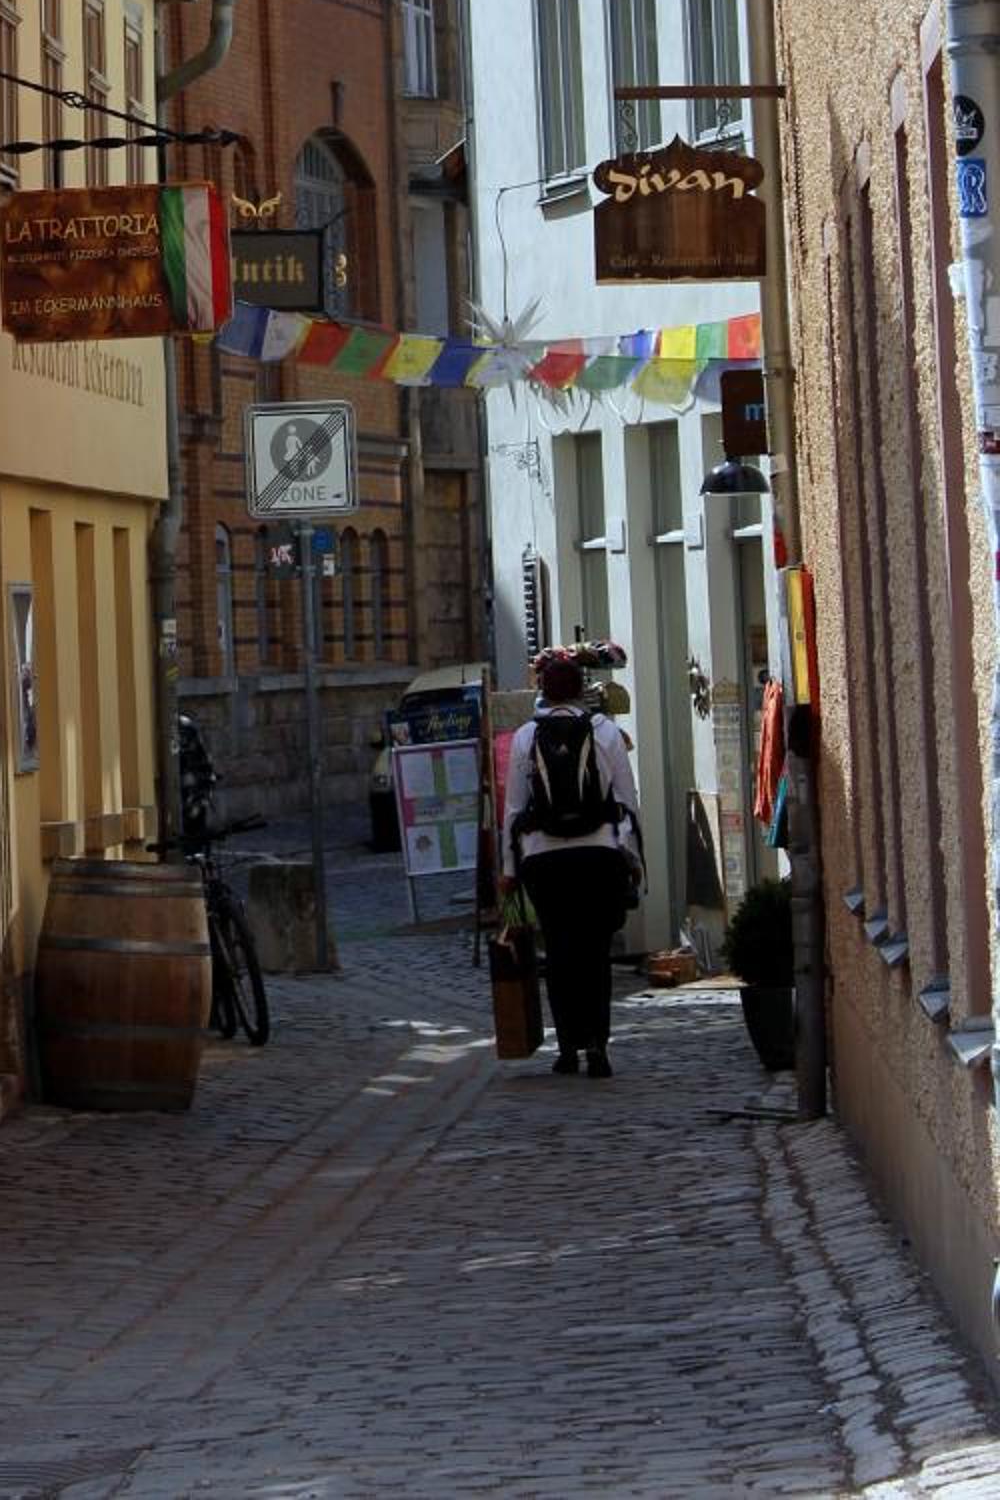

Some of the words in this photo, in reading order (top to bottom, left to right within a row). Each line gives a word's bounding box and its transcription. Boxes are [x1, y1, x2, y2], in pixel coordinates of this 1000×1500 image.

[5, 220, 33, 243] LA
[36, 212, 161, 241] TRATTORIA
[280, 485, 327, 503] ZONE
